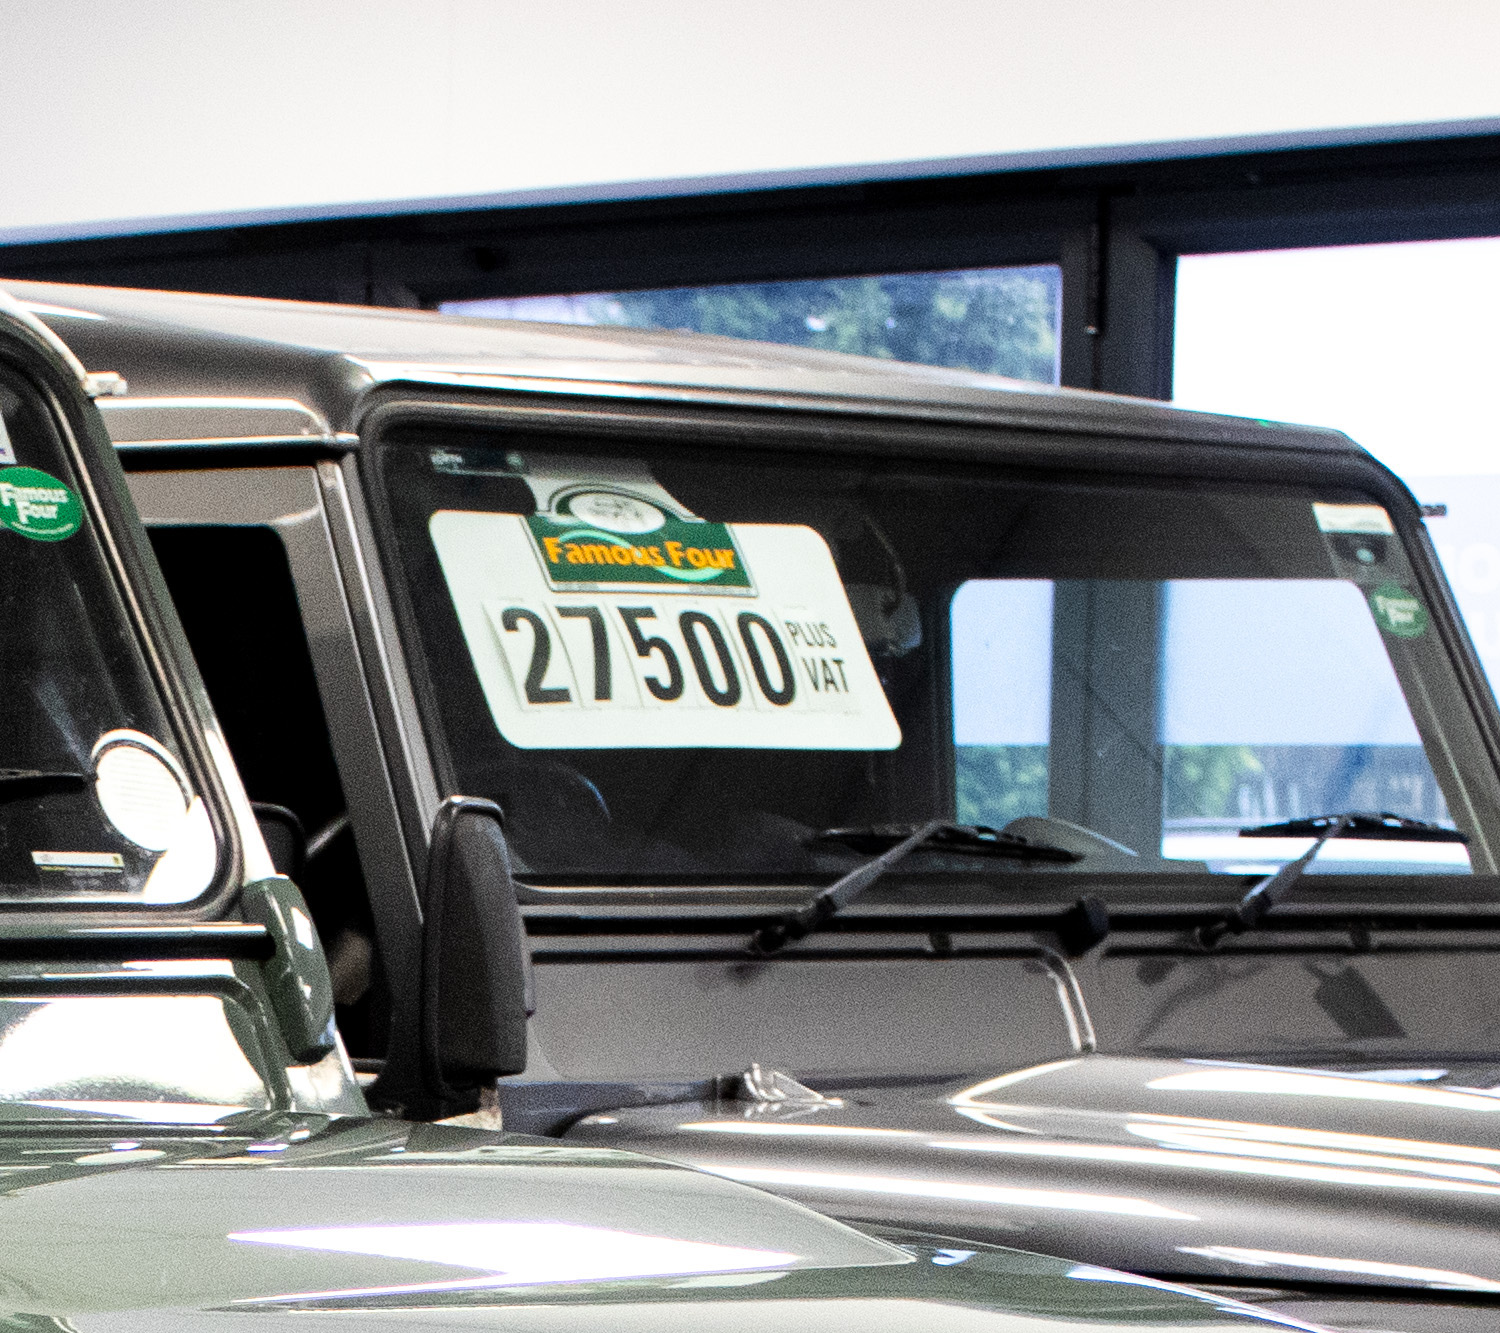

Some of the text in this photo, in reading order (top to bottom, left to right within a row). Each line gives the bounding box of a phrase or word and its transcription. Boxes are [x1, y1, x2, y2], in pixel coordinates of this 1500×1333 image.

[16, 501, 58, 525] Four
[544, 537, 736, 571] Famous Four
[786, 620, 837, 647] PLUS
[503, 605, 796, 707] 27500
[804, 658, 850, 695] VAT
